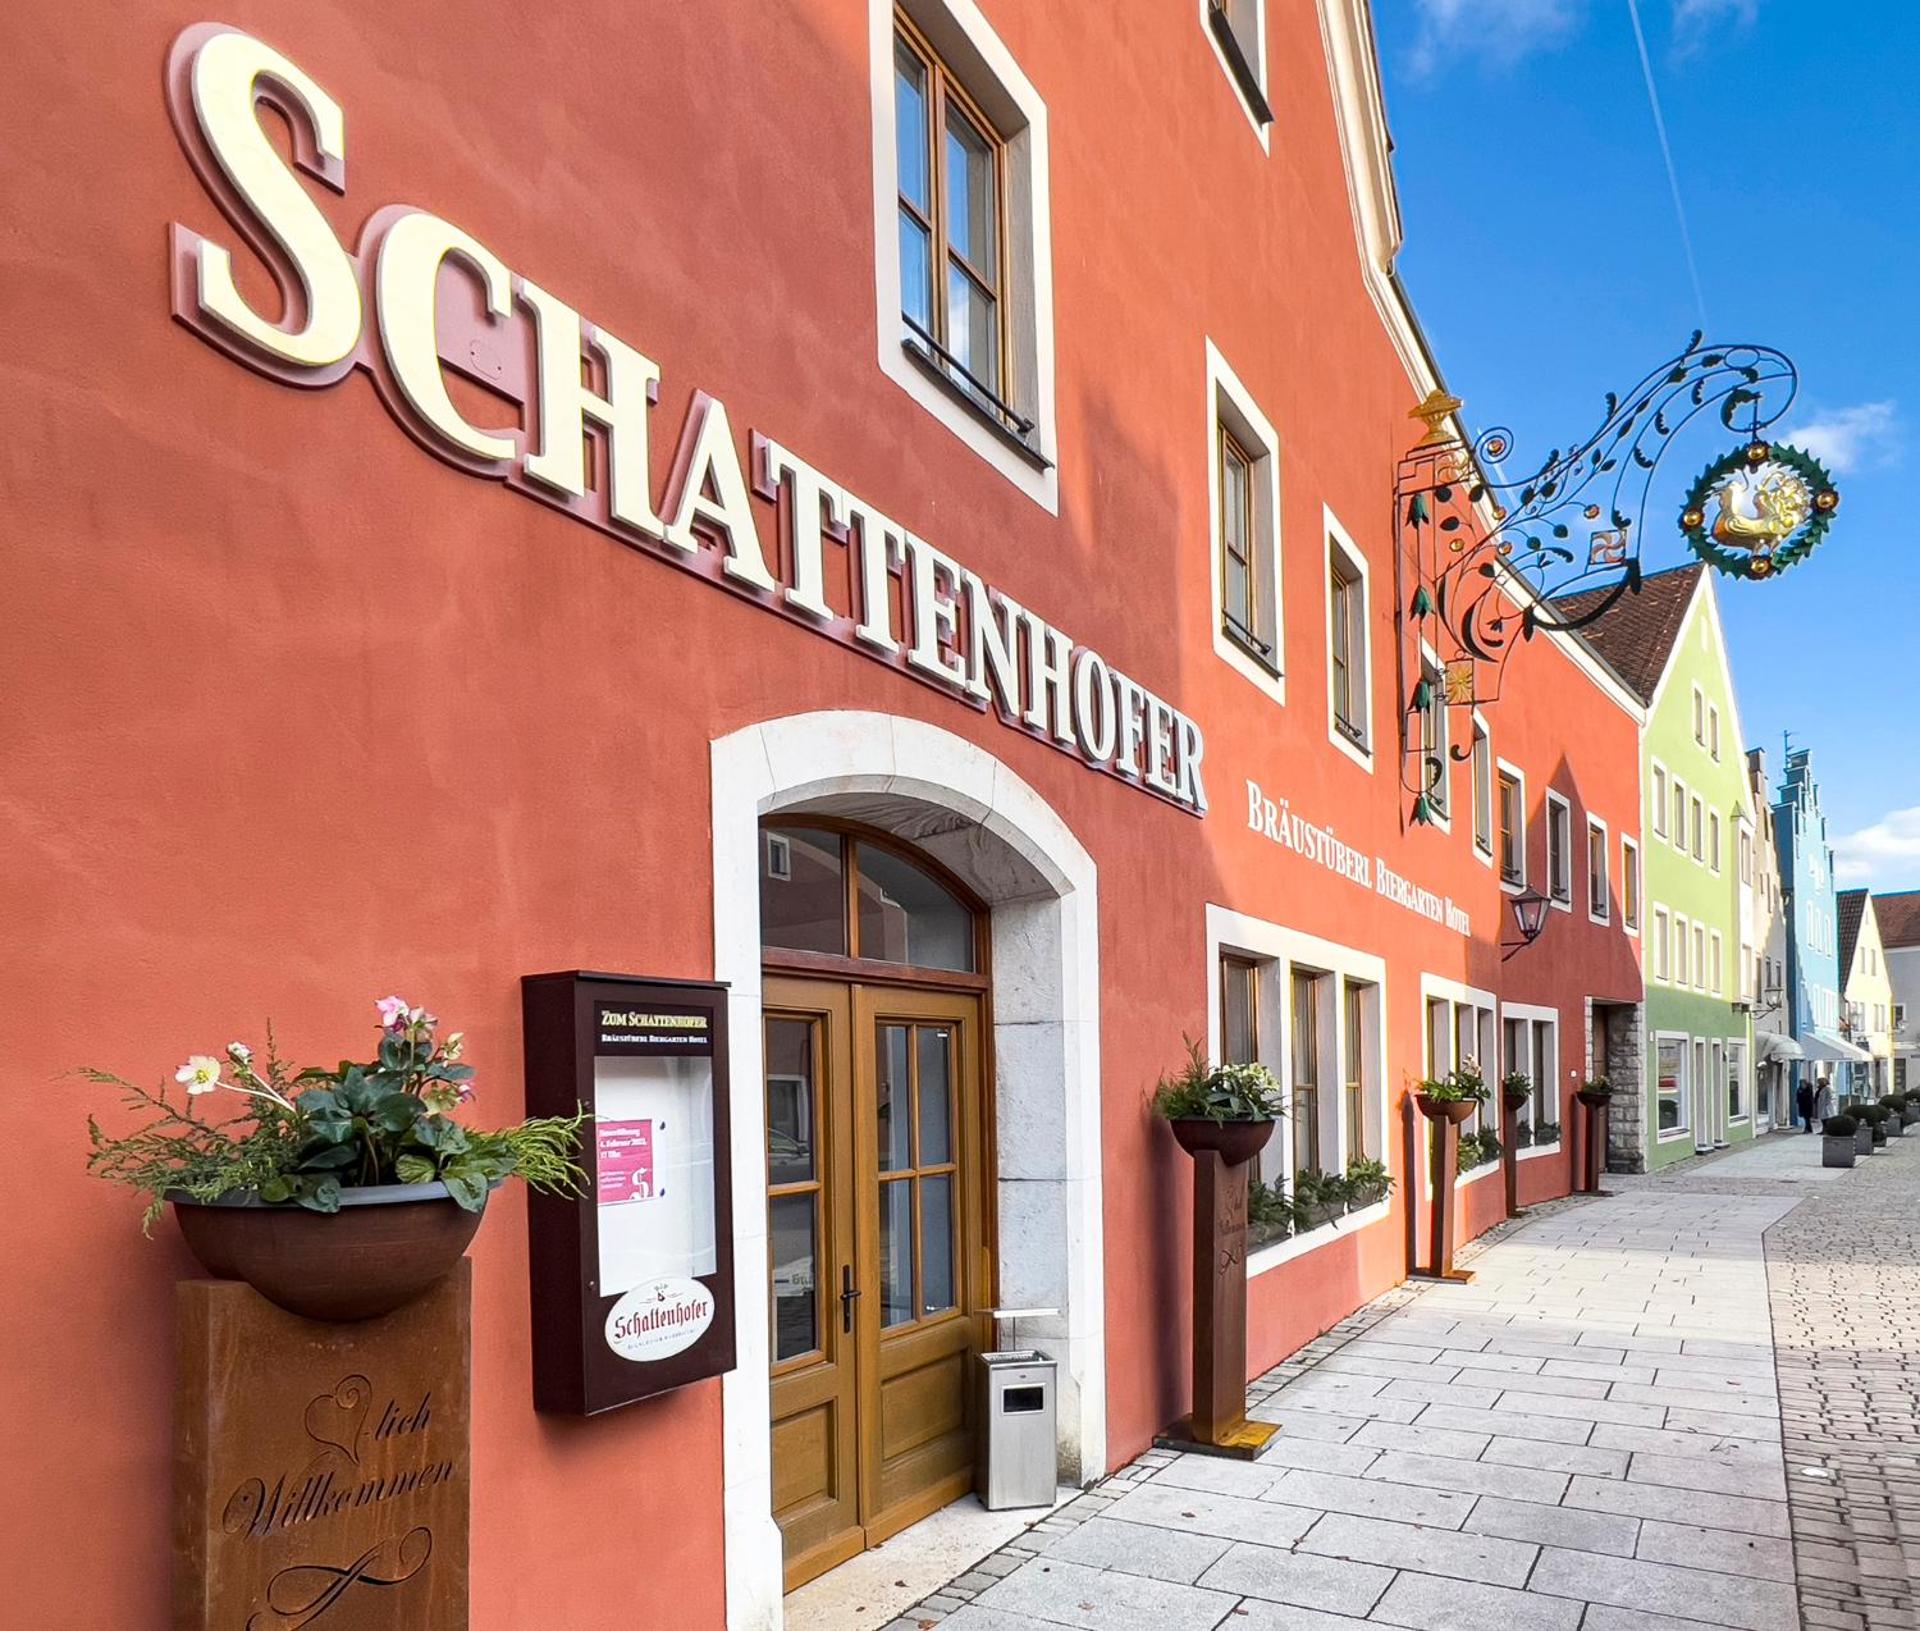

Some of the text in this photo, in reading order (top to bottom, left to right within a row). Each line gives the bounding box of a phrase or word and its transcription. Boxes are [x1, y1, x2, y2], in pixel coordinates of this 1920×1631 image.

[180, 28, 1208, 814] SCHATTENHOFER
[1246, 778, 1471, 937] BRÄUSTÜBERL BIERGARTEN HOTEL
[601, 1010, 708, 1028] ZUM SCHATTENHOFER
[613, 1299, 708, 1340] Schattenhofer
[222, 1452, 453, 1543] Willkommen
